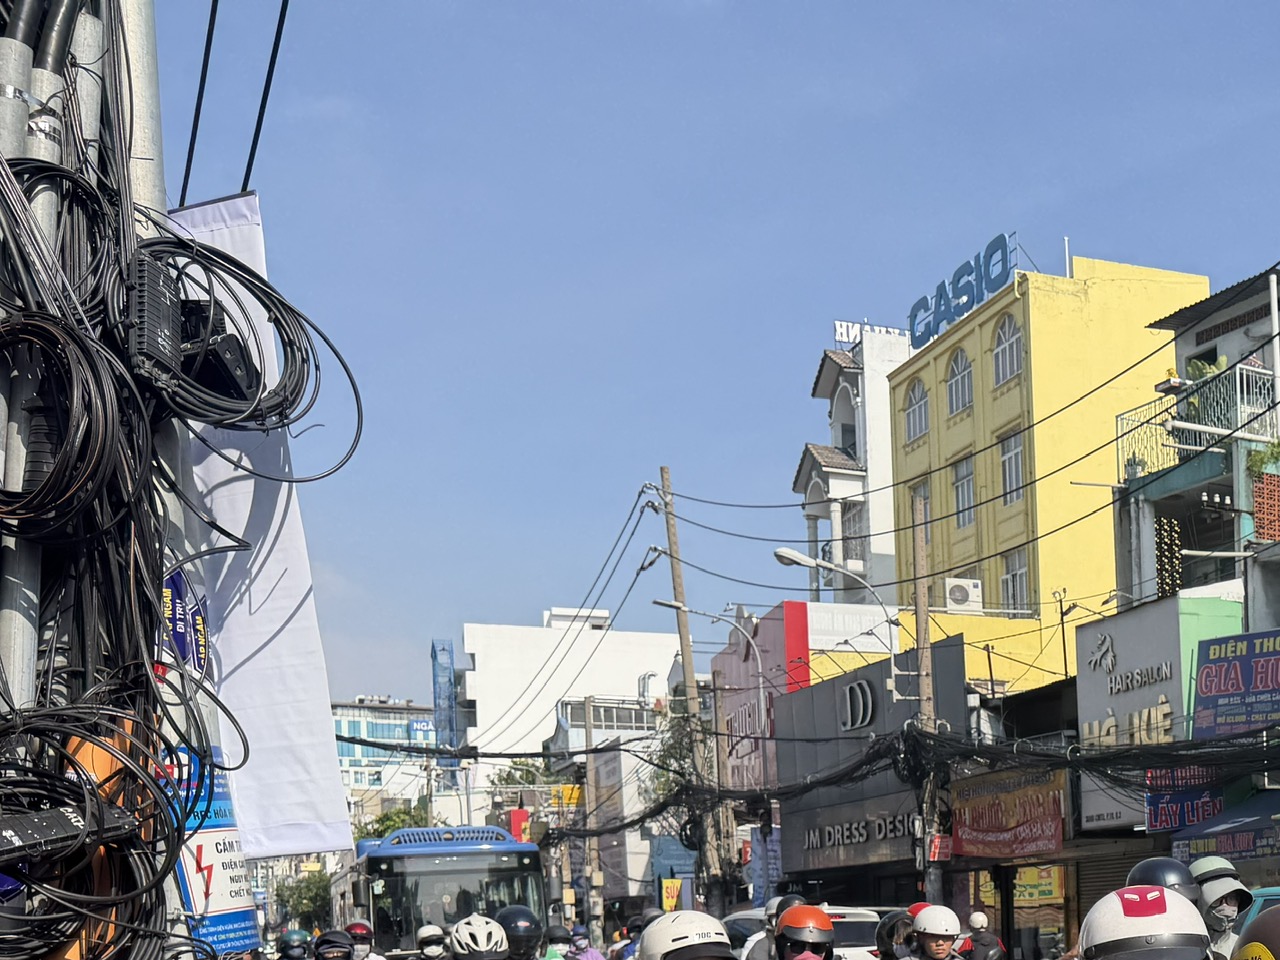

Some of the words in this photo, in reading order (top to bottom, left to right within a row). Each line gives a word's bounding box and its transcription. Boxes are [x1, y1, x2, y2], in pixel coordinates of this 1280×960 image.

[908, 232, 1011, 350] CASIO
[1209, 640, 1247, 660] ĐIỆN
[1107, 672, 1133, 695] HAIR
[1133, 661, 1172, 687] SALON
[1197, 661, 1244, 697] GIA
[1148, 795, 1180, 830] LẤY
[215, 837, 236, 854] CẤM
[803, 828, 821, 849] JM
[825, 821, 868, 847] DRESS
[875, 813, 916, 840] DESI
[222, 859, 239, 872] ĐIỆN
